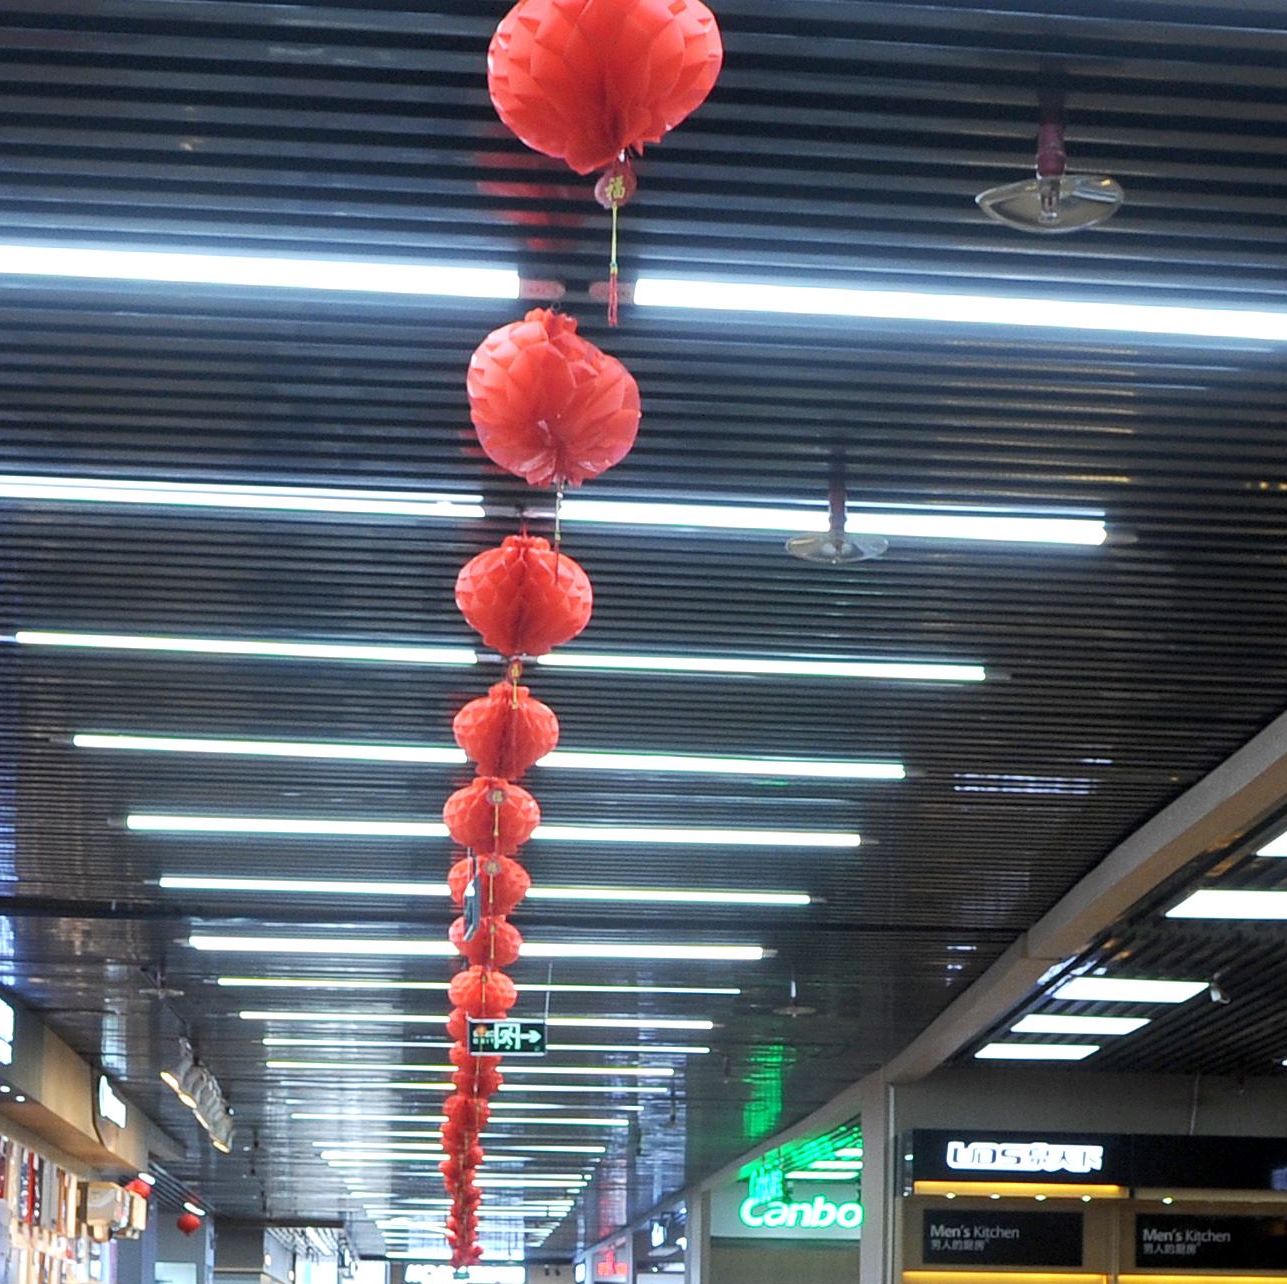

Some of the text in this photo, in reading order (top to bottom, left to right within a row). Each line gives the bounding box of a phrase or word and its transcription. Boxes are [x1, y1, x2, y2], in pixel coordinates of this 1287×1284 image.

[739, 1195, 863, 1229] Canbo
[930, 1223, 1020, 1239] Men's Kitchen
[1142, 1227, 1231, 1243] Men's Kitchen
